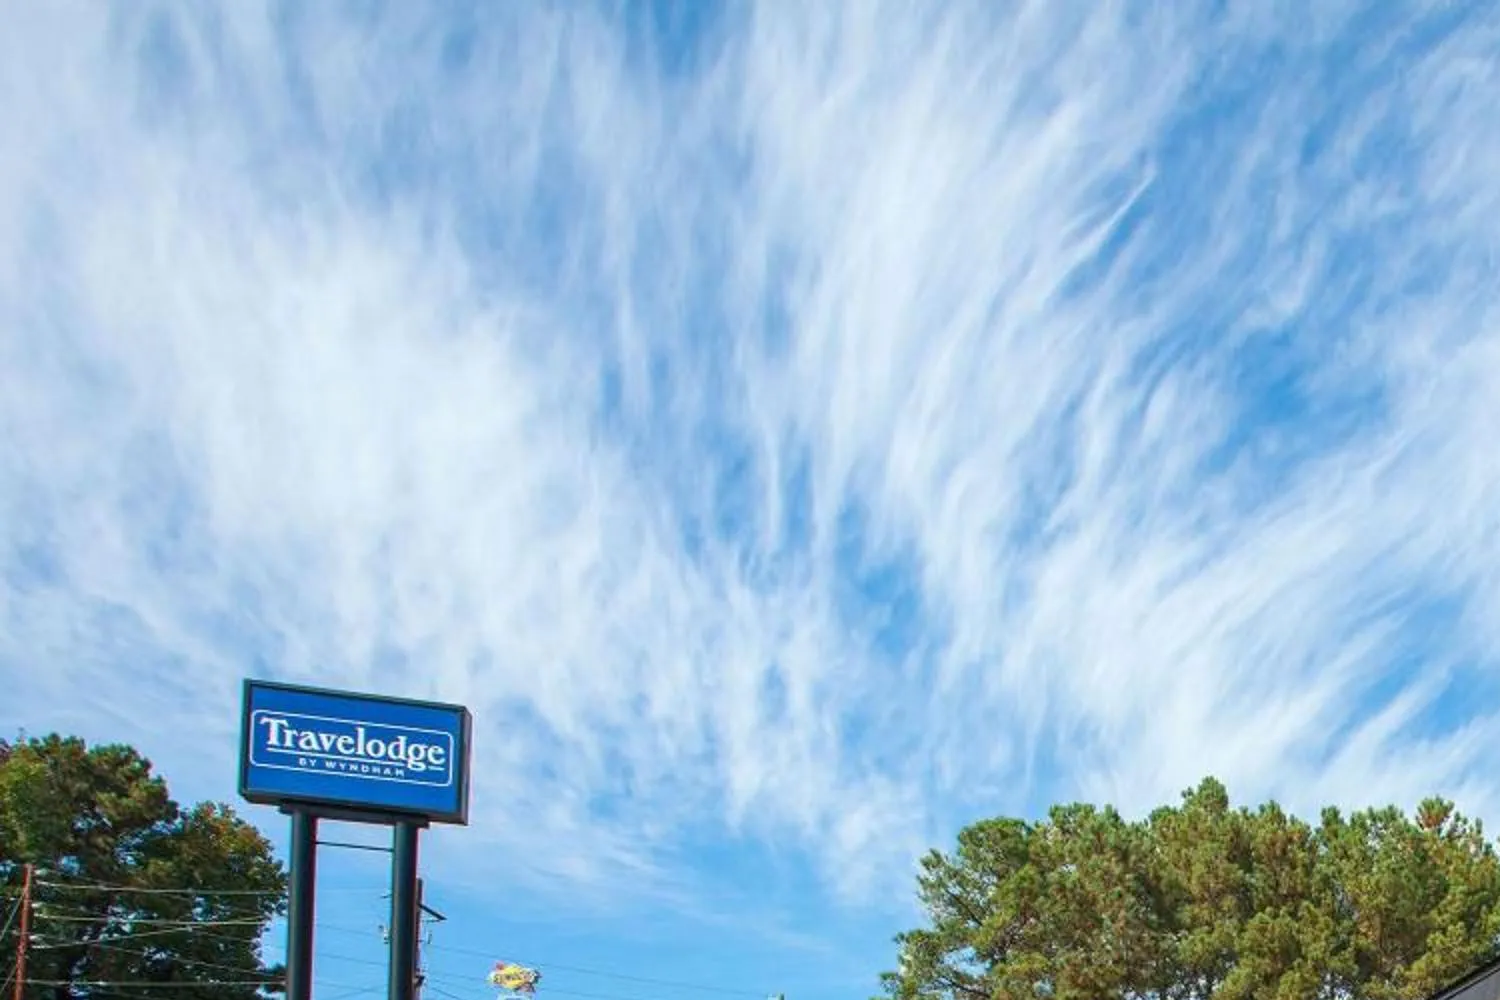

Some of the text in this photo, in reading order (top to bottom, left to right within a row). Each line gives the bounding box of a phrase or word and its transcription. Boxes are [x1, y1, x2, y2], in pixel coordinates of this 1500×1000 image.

[260, 717, 446, 771] Travelodge
[299, 757, 405, 777] BY WYNDHAM
